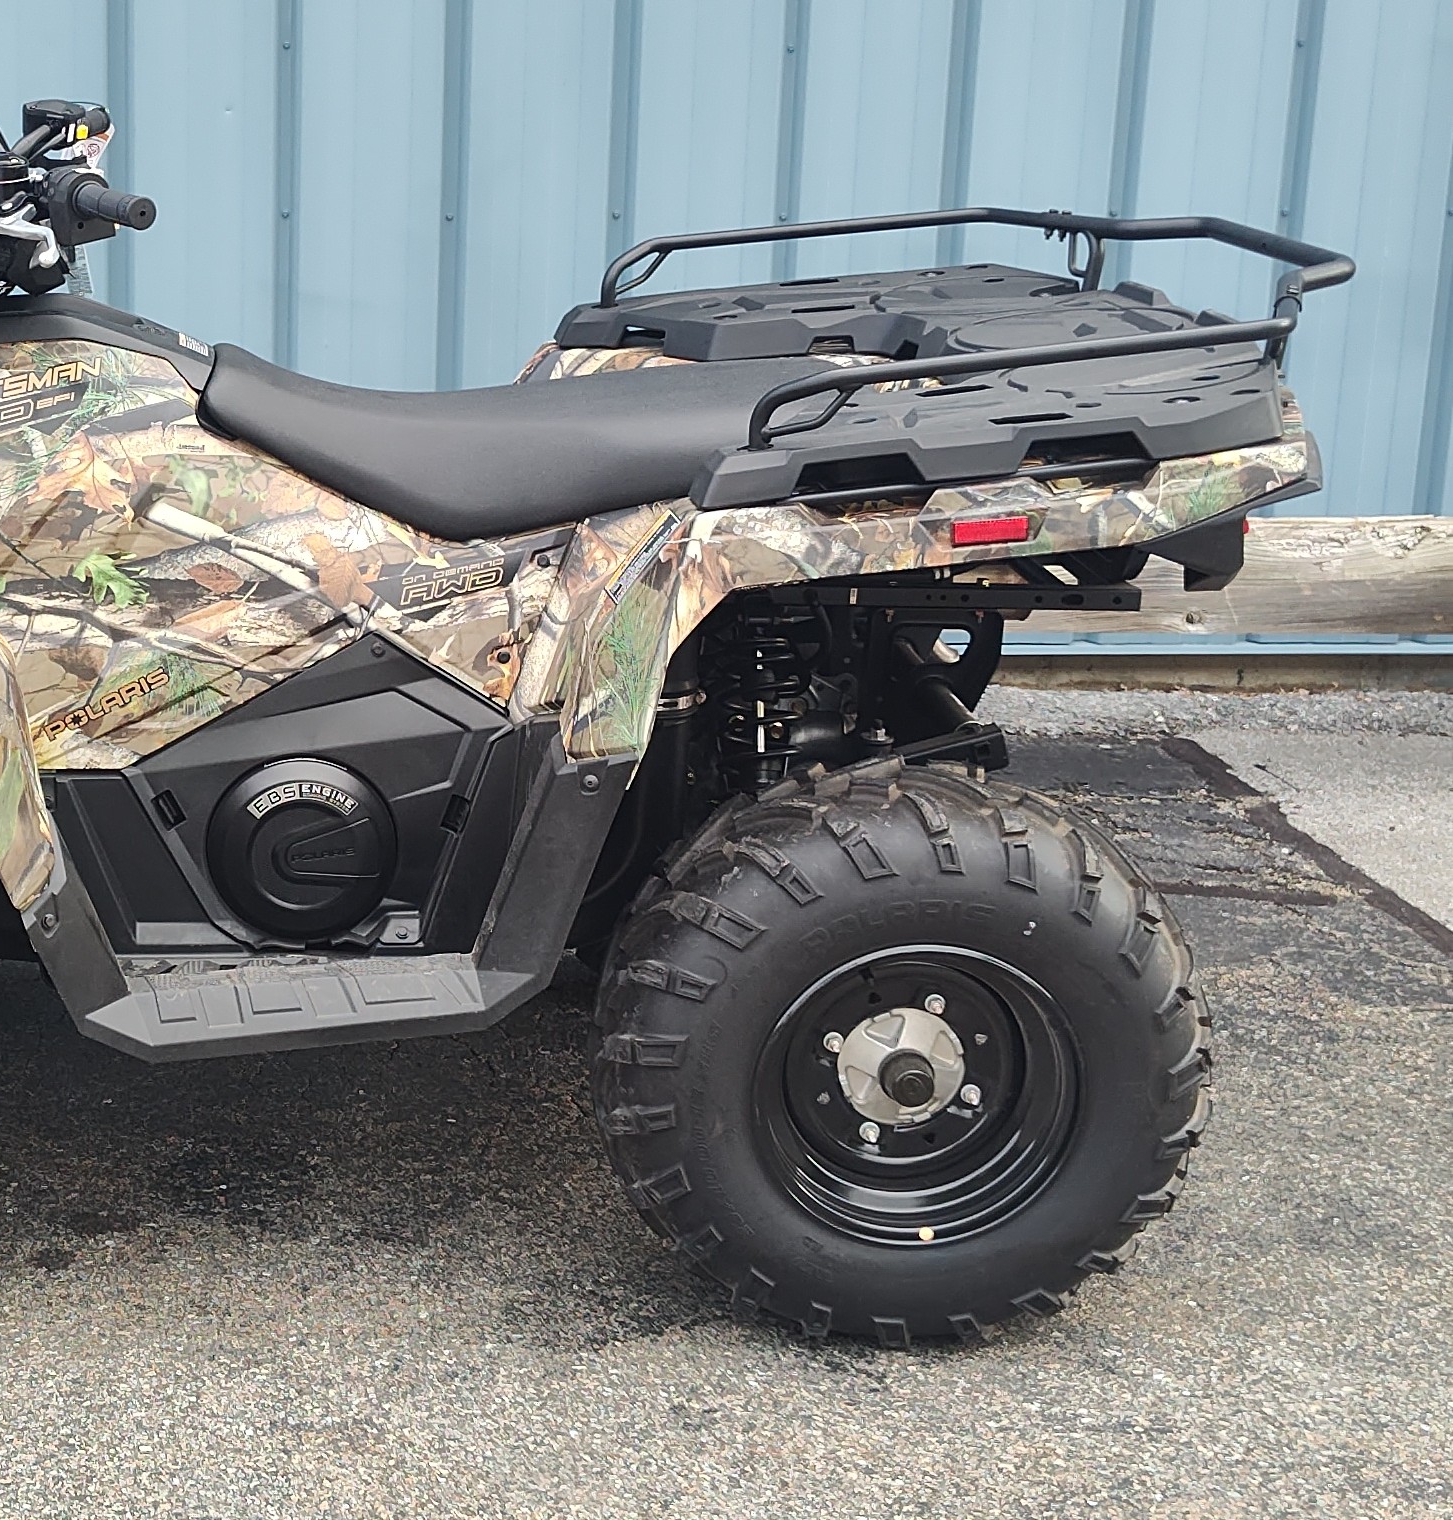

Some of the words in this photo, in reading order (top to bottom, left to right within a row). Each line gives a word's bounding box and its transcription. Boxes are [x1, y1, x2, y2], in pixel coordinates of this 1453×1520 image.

[400, 566, 504, 606] AWD
[43, 666, 170, 741] POLARIS
[253, 785, 296, 813] EBS
[301, 783, 355, 806] ENGINE
[291, 847, 355, 863] POLARIS
